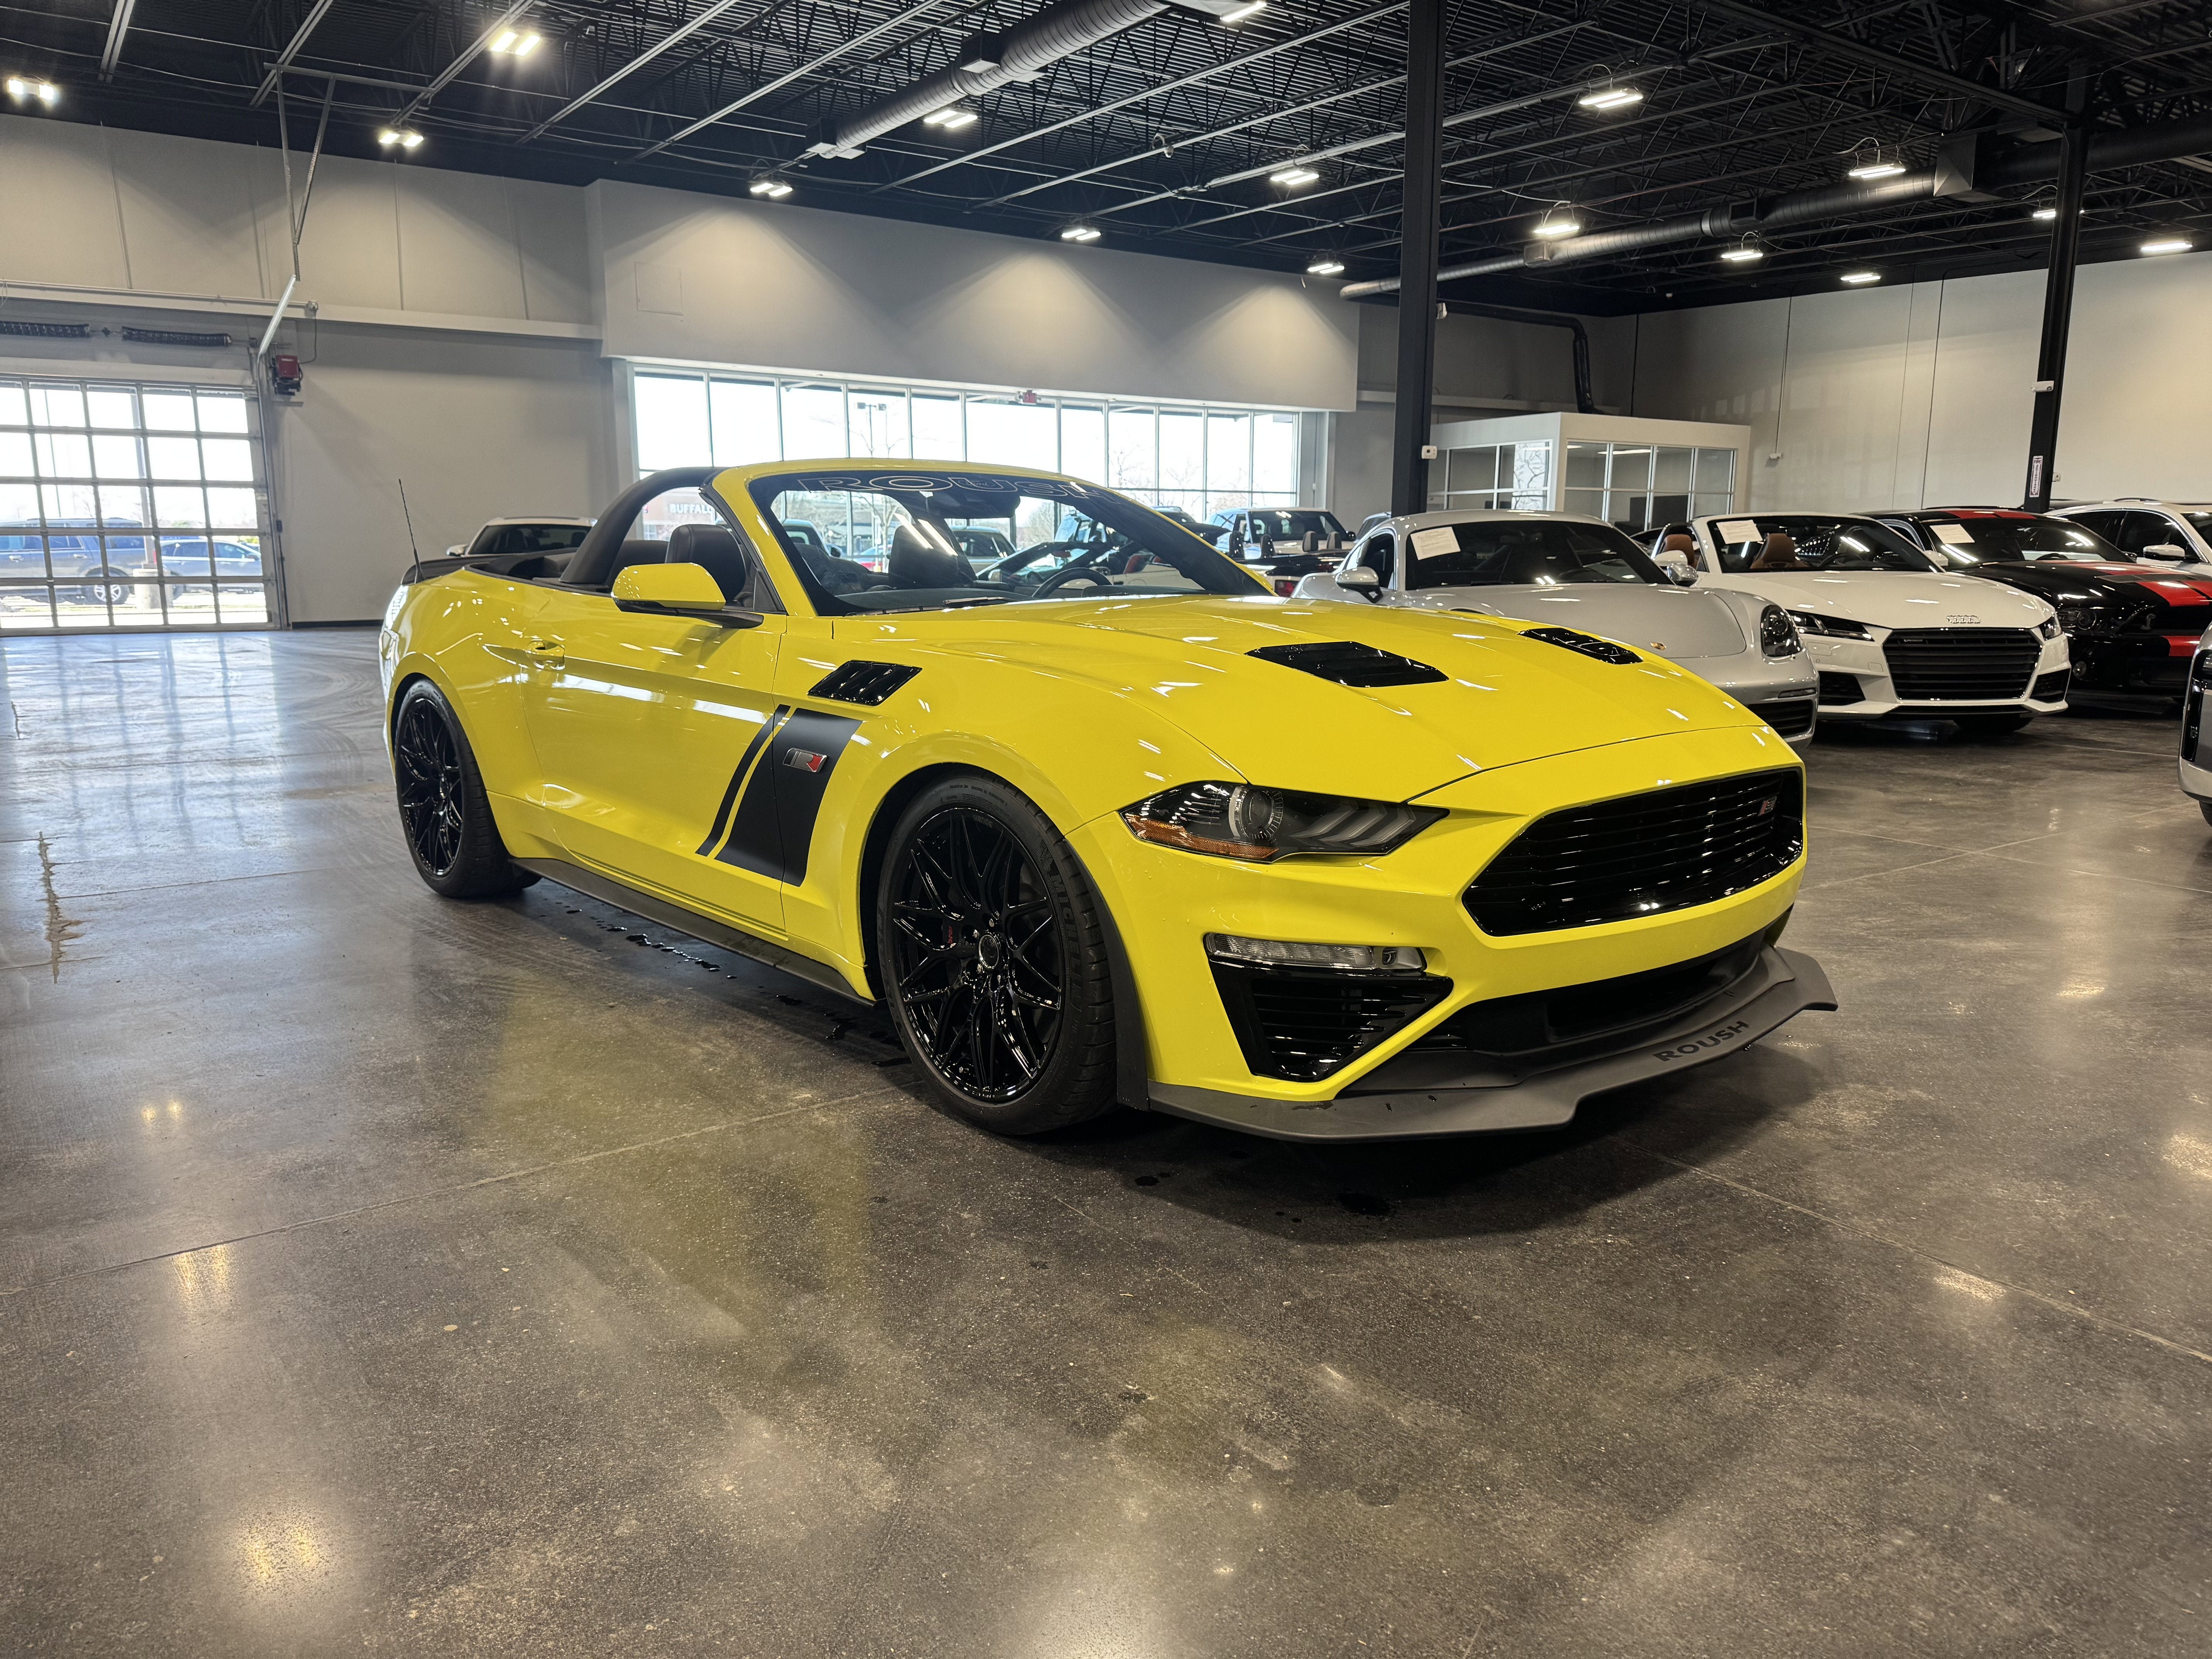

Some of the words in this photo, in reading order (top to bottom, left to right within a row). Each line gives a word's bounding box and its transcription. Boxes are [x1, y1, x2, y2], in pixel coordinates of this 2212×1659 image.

[797, 476, 1121, 504] ROUSH
[1051, 874, 1082, 1003] MICHELIN
[1653, 1020, 1750, 1062] ROUSH
